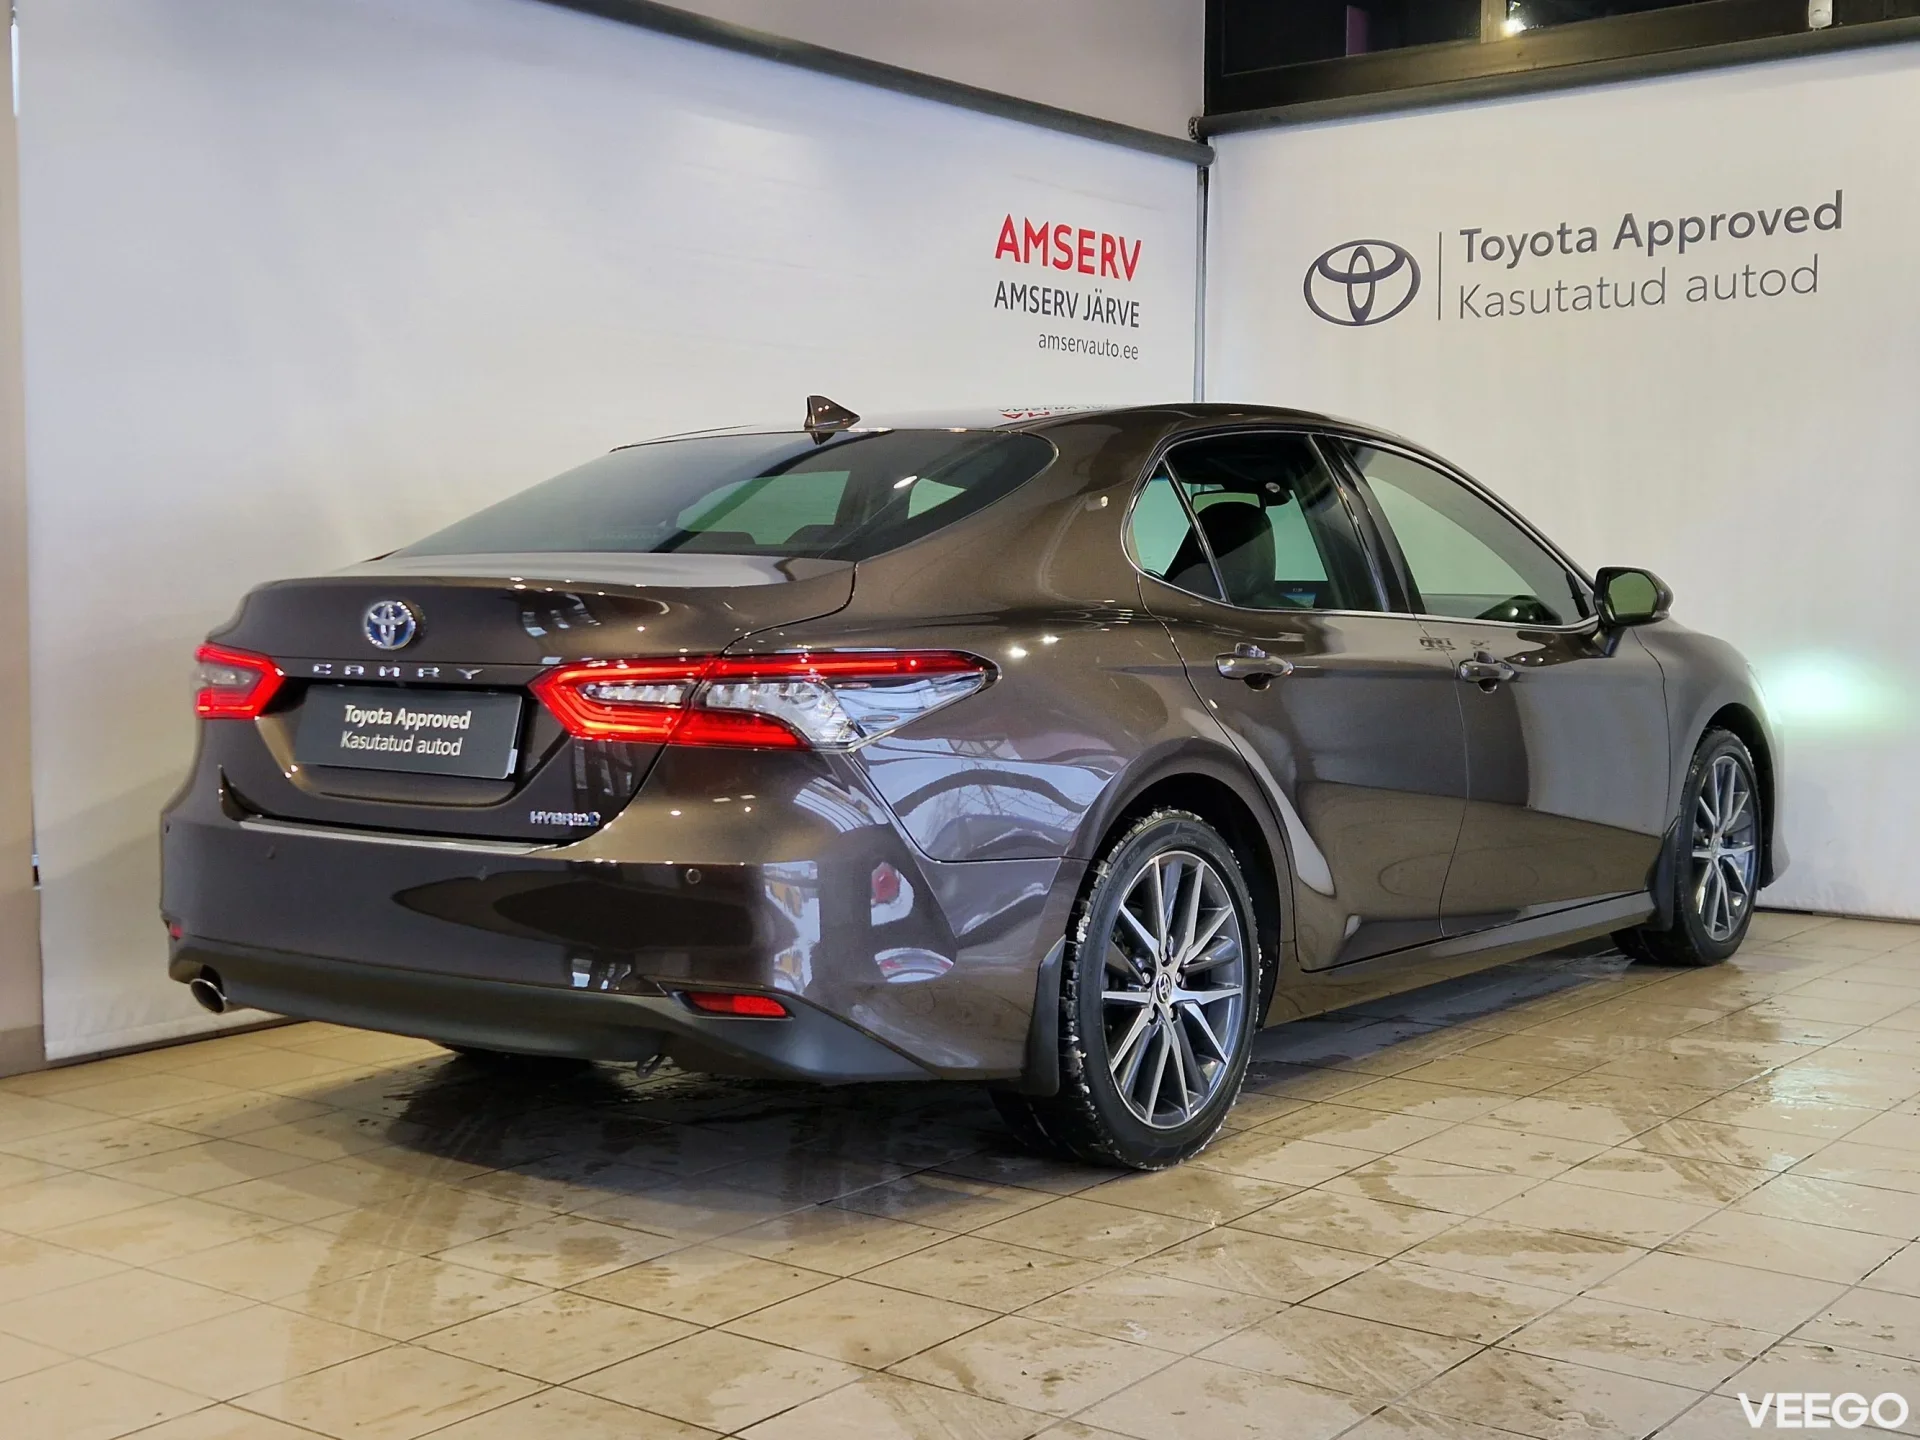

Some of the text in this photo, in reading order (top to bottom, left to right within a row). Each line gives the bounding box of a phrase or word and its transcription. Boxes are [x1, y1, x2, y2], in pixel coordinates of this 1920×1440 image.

[1459, 189, 1843, 269] Toyota Approved
[995, 213, 1142, 281] AMSERV
[1459, 253, 1819, 319] Kasutatud autod
[994, 280, 1140, 328] AMSERV JÄRVE
[1038, 333, 1139, 360] amservauto.ee
[312, 663, 484, 680] CAMRY
[344, 704, 472, 731] Toyota Approved
[340, 730, 463, 756] Kasutatud autod
[530, 810, 590, 826] HYBRID
